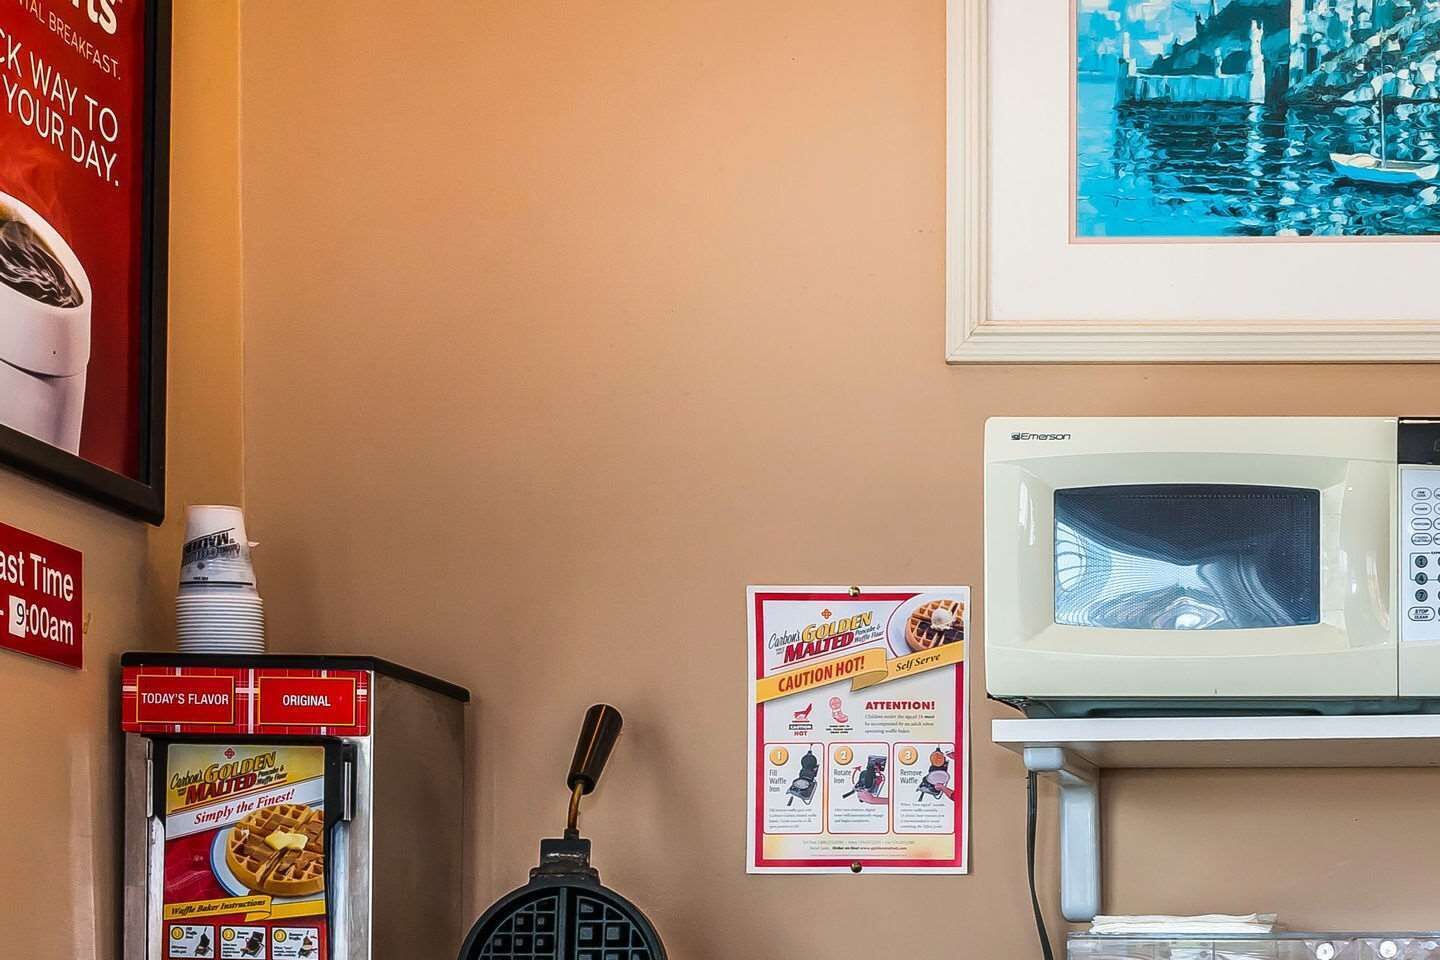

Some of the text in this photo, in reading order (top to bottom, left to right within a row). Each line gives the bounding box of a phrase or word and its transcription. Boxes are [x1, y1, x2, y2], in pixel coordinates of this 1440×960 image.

[48, 11, 121, 81] BREAKFAST.
[30, 51, 78, 116] WAY
[84, 94, 119, 142] TO
[2, 73, 120, 187] YOUR DAY.
[1020, 432, 1071, 441] Emerson
[30, 552, 74, 601] Time
[16, 603, 74, 645] 9:00am
[801, 611, 873, 643] GOLDEN
[783, 631, 854, 663] MALTED
[778, 655, 865, 693] CAUTION HOT!
[895, 654, 942, 673] Self Serve
[141, 692, 230, 706] TODAY'S FLAVOR
[282, 694, 331, 707] ORIGINAL
[865, 700, 935, 710] ATTENTION!
[203, 751, 277, 783] GOLDEN
[900, 768, 922, 776] Remove
[184, 773, 258, 805] MALTED
[193, 788, 295, 826] Simply the Finest!
[171, 899, 266, 917] Waffle Baker Instructions
